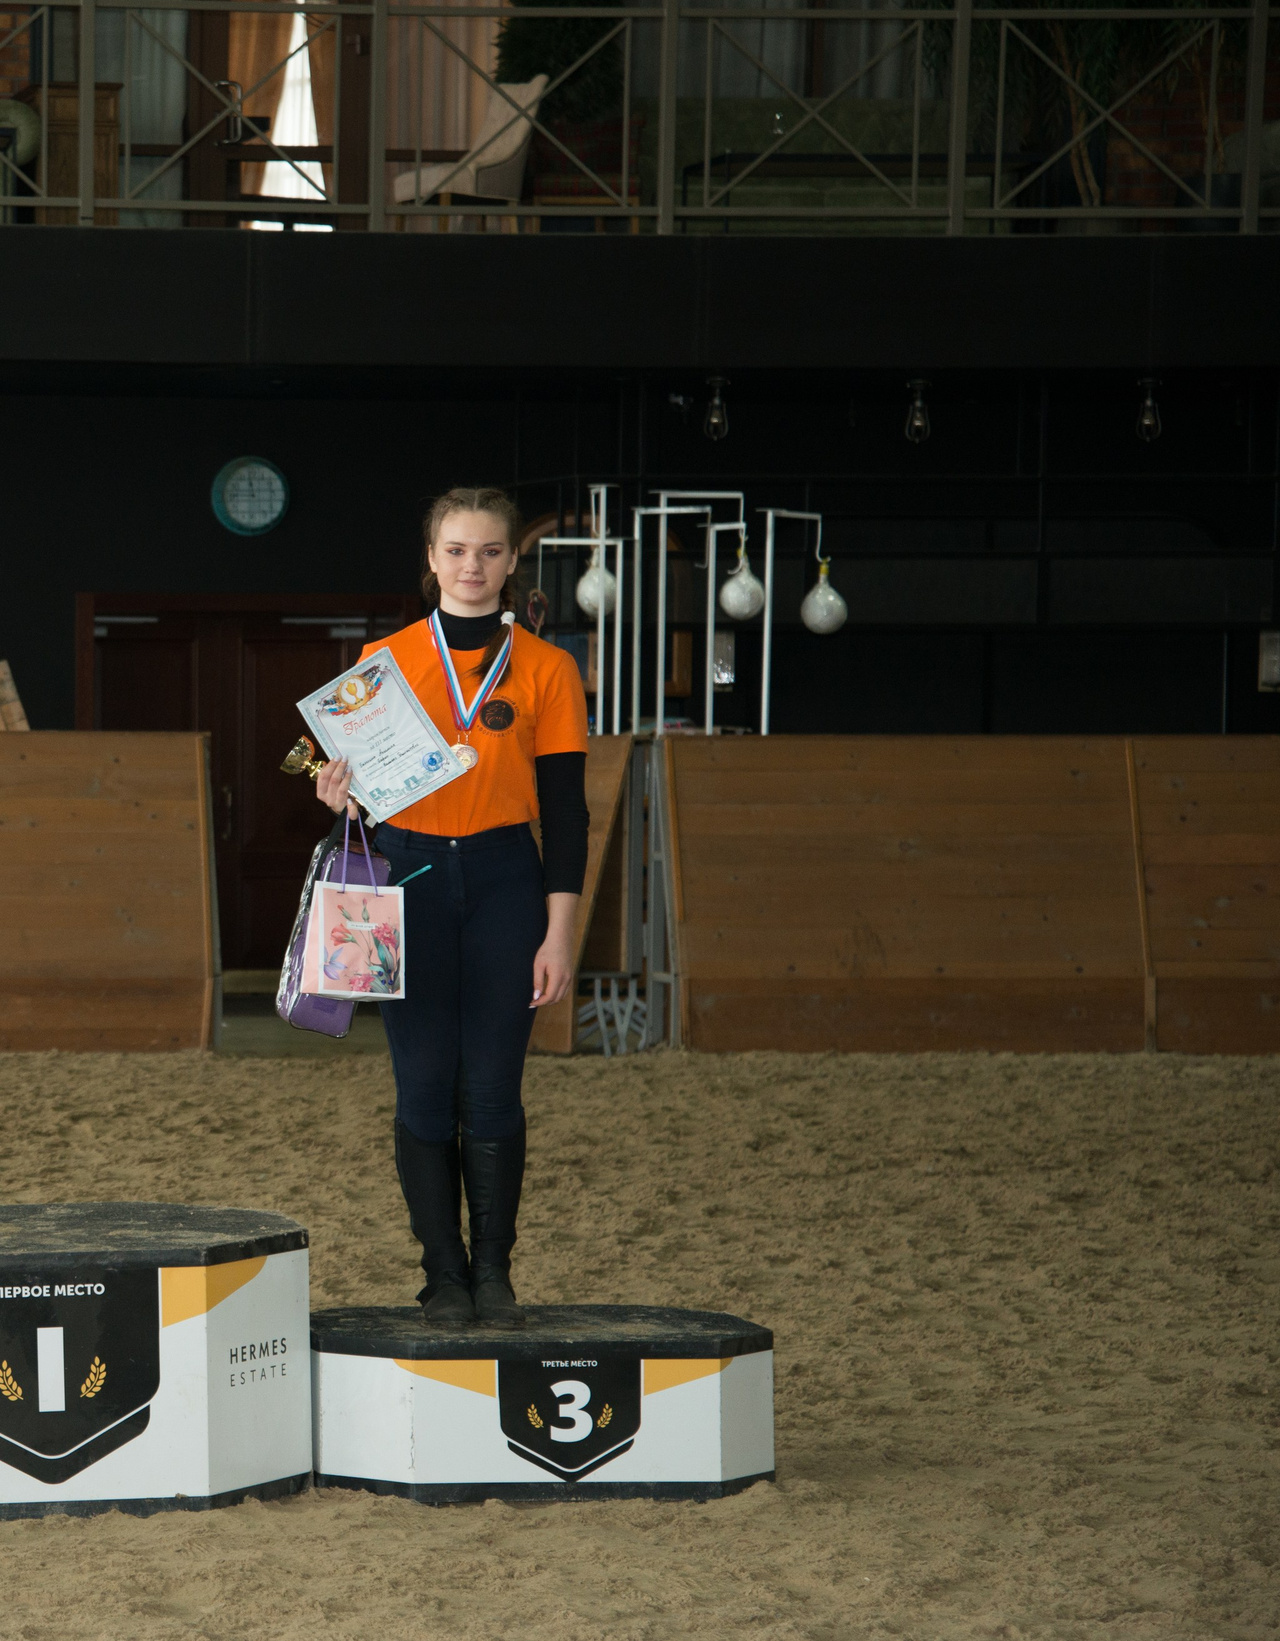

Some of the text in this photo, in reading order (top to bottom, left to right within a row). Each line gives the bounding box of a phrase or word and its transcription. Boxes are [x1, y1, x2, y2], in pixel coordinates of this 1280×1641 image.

[342, 703, 387, 736] Грамота
[54, 1282, 106, 1297] МЕСТО
[229, 1337, 287, 1365] HERMES
[541, 1360, 569, 1368] ТРЕТЬЕ
[230, 1362, 287, 1387] ESTATE
[549, 1379, 594, 1443] 3
